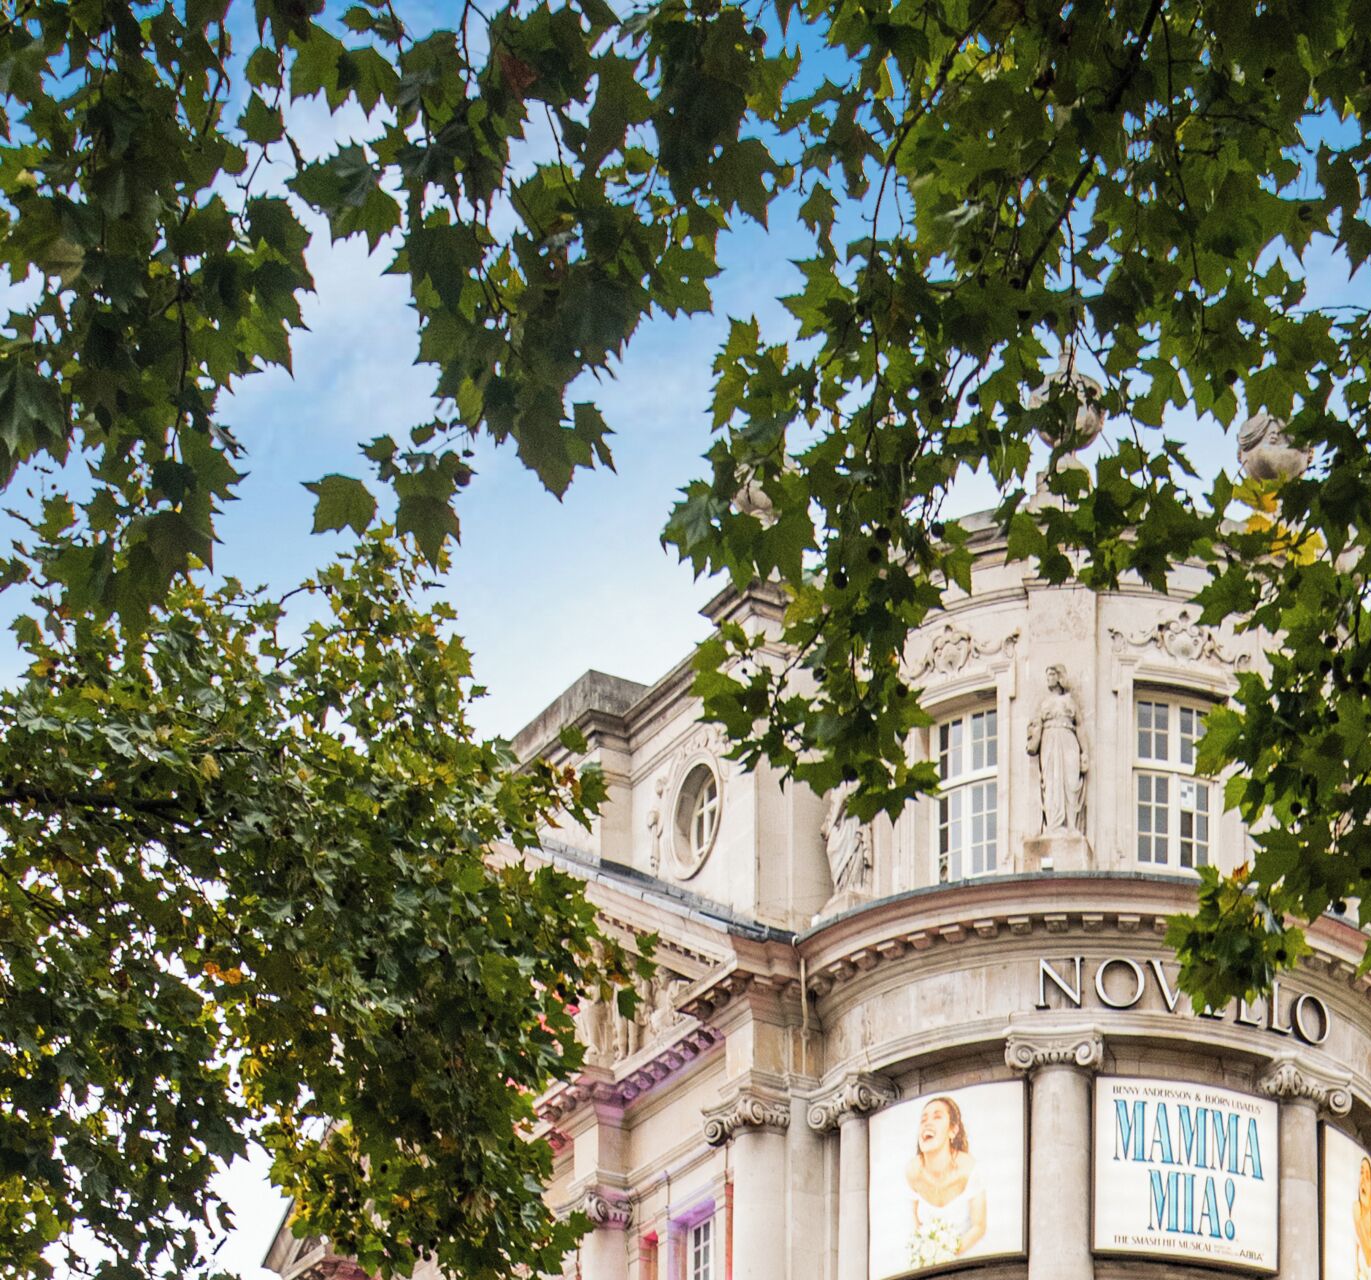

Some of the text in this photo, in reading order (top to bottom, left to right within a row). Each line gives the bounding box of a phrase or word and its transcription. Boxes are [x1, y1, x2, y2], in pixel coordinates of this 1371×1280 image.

[1034, 956, 1332, 1045] NOVLLO
[1112, 1085, 1140, 1095] BENNY
[1142, 1086, 1192, 1101] ANDERSSON
[1113, 1099, 1264, 1179] MAMMA
[1147, 1169, 1235, 1241] MIA!
[1114, 1235, 1128, 1244] THE
[1131, 1235, 1161, 1246] SMASH
[1162, 1238, 1176, 1248] HIT
[1178, 1240, 1212, 1252] MUSICAL
